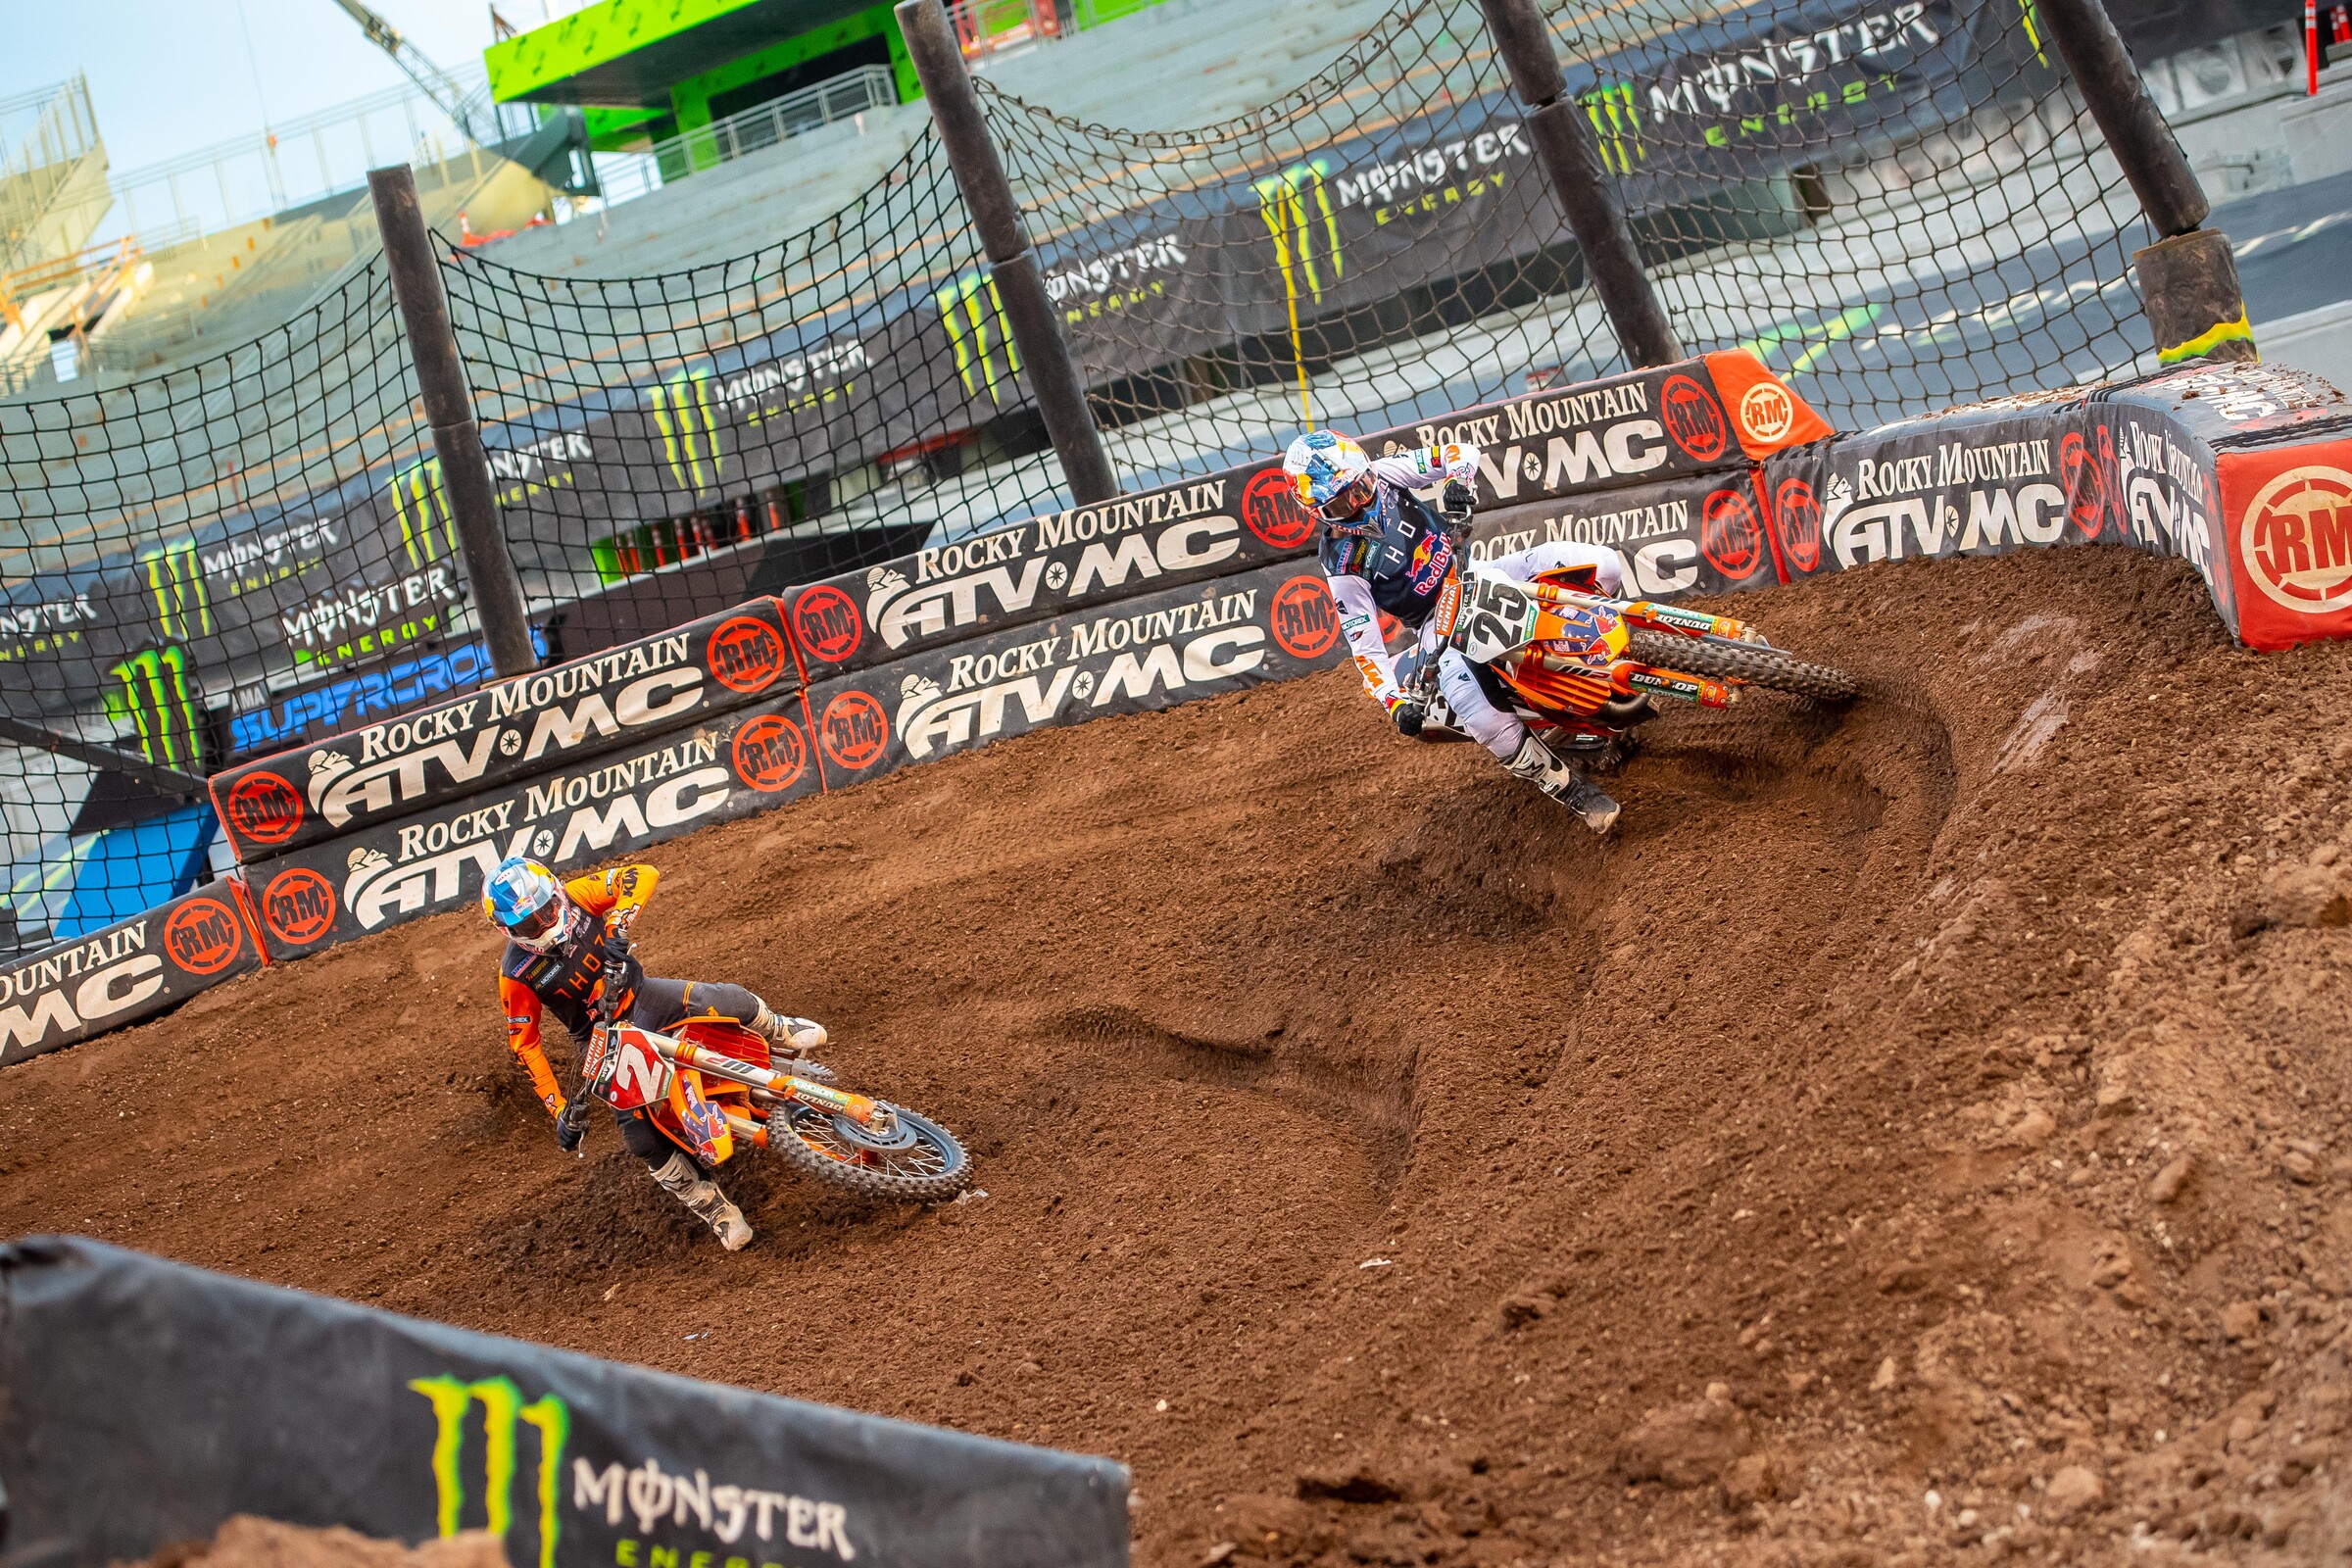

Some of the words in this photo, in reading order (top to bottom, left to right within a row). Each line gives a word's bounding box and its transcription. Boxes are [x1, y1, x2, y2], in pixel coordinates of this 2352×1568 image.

[1648, 1, 1939, 123] MONSTER
[1704, 73, 1898, 147] ENERGY
[1335, 122, 1532, 208] MONSTER
[1374, 172, 1505, 226] ENERGY
[1044, 233, 1187, 309] ONSTER
[1055, 279, 1164, 324] NERGY
[715, 338, 873, 413] MONSTER
[748, 381, 854, 427] ENERGY
[1416, 415, 1500, 449] ROCKY
[1504, 382, 1648, 441] MOUNTAIN
[486, 430, 592, 482] NSTER
[1857, 455, 1933, 501] ROCKY
[1936, 439, 2050, 488] MOUNTAIN
[495, 471, 572, 507] NERGY
[204, 517, 339, 581] MONSTER
[915, 526, 1025, 584] ROCKY
[1035, 480, 1227, 552] MOUNTAIN
[1470, 526, 1534, 564] OCKY
[1544, 499, 1688, 546] MOUNTAIN
[230, 556, 320, 595] ENERGY
[281, 566, 456, 647] MONSTER
[1436, 577, 1449, 630] RENTHL
[0, 594, 96, 639] NSTER
[317, 614, 437, 666] ENERGY
[947, 637, 1061, 693] ROCKY
[1067, 589, 1257, 662] MOUNTAIN
[1472, 578, 1529, 649] 25
[0, 631, 79, 662] NERGY
[359, 700, 478, 764] ROCKY
[487, 632, 690, 723] MOUNTAIN
[1631, 673, 1698, 694] DUNOP
[398, 800, 515, 862] ROCKY
[524, 730, 718, 821] MOUNTAIN
[0, 920, 147, 1004] OUNTAIN
[540, 963, 562, 985] MOTOREX
[582, 1032, 599, 1076] RENTHAL
[615, 1043, 664, 1104] 2
[793, 1078, 835, 1101] MOTOREX
[572, 1456, 856, 1561] MONSTER
